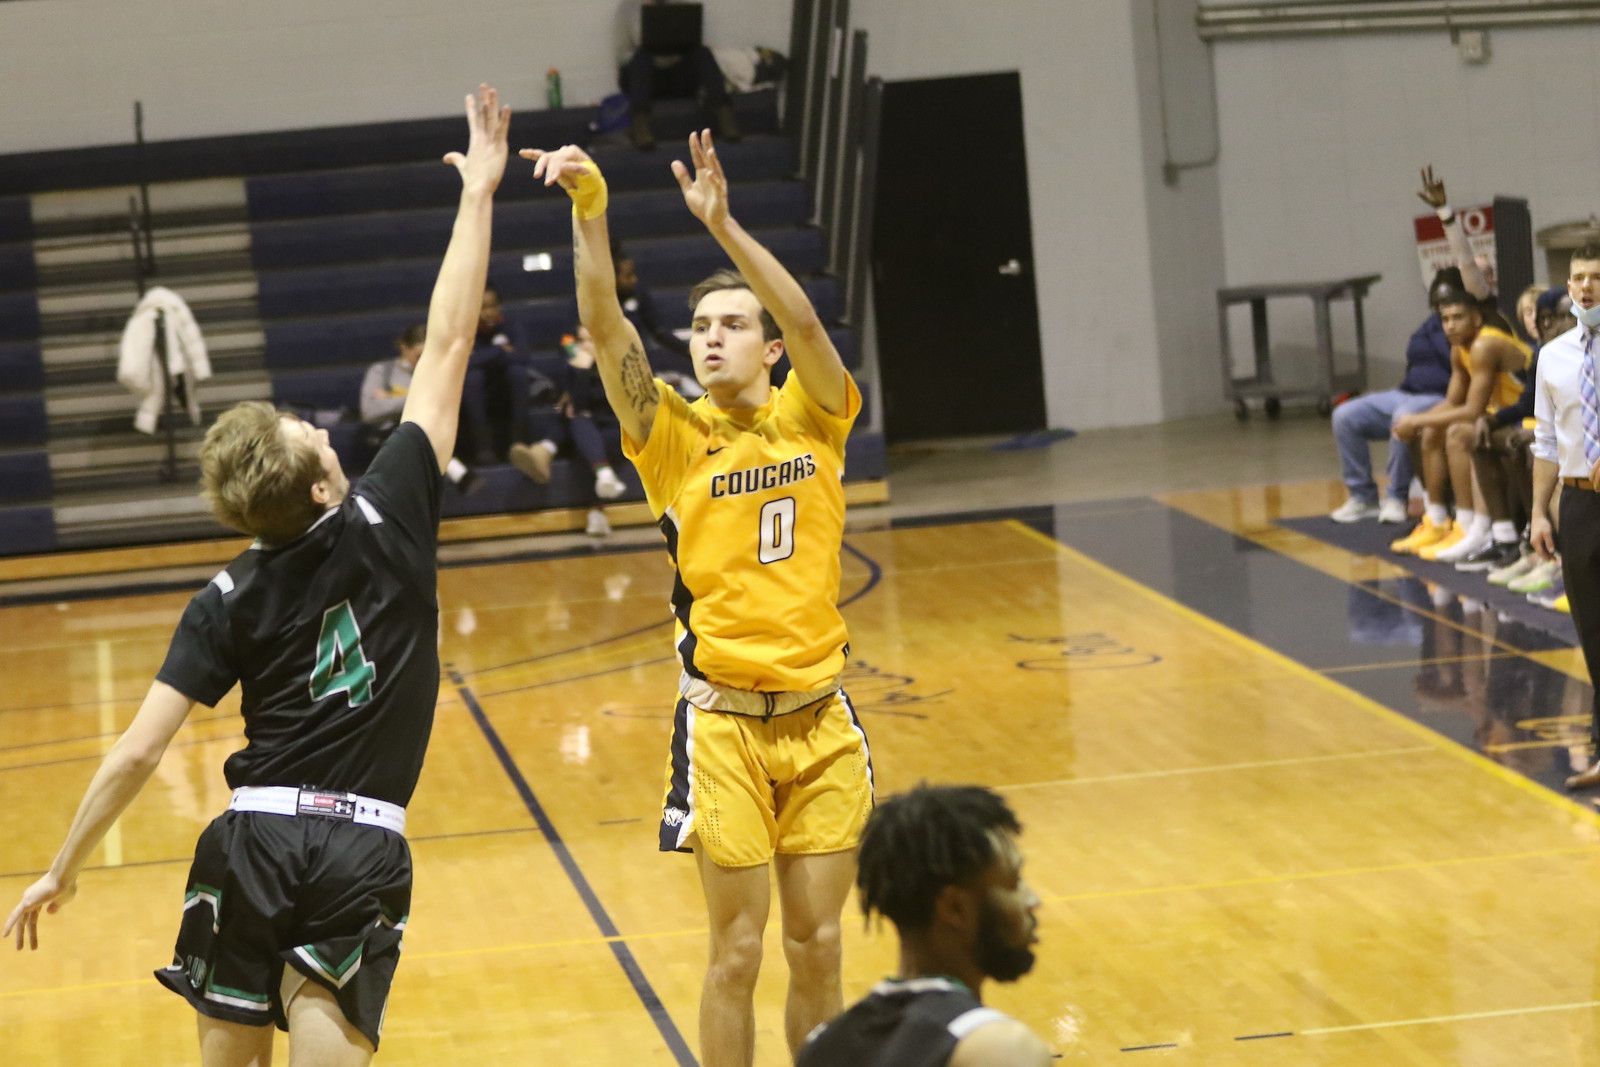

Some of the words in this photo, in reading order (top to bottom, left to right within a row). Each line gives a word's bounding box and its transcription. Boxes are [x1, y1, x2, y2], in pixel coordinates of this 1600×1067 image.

[711, 454, 816, 498] COUGARS
[758, 496, 796, 565] 0
[308, 599, 376, 708] 4
